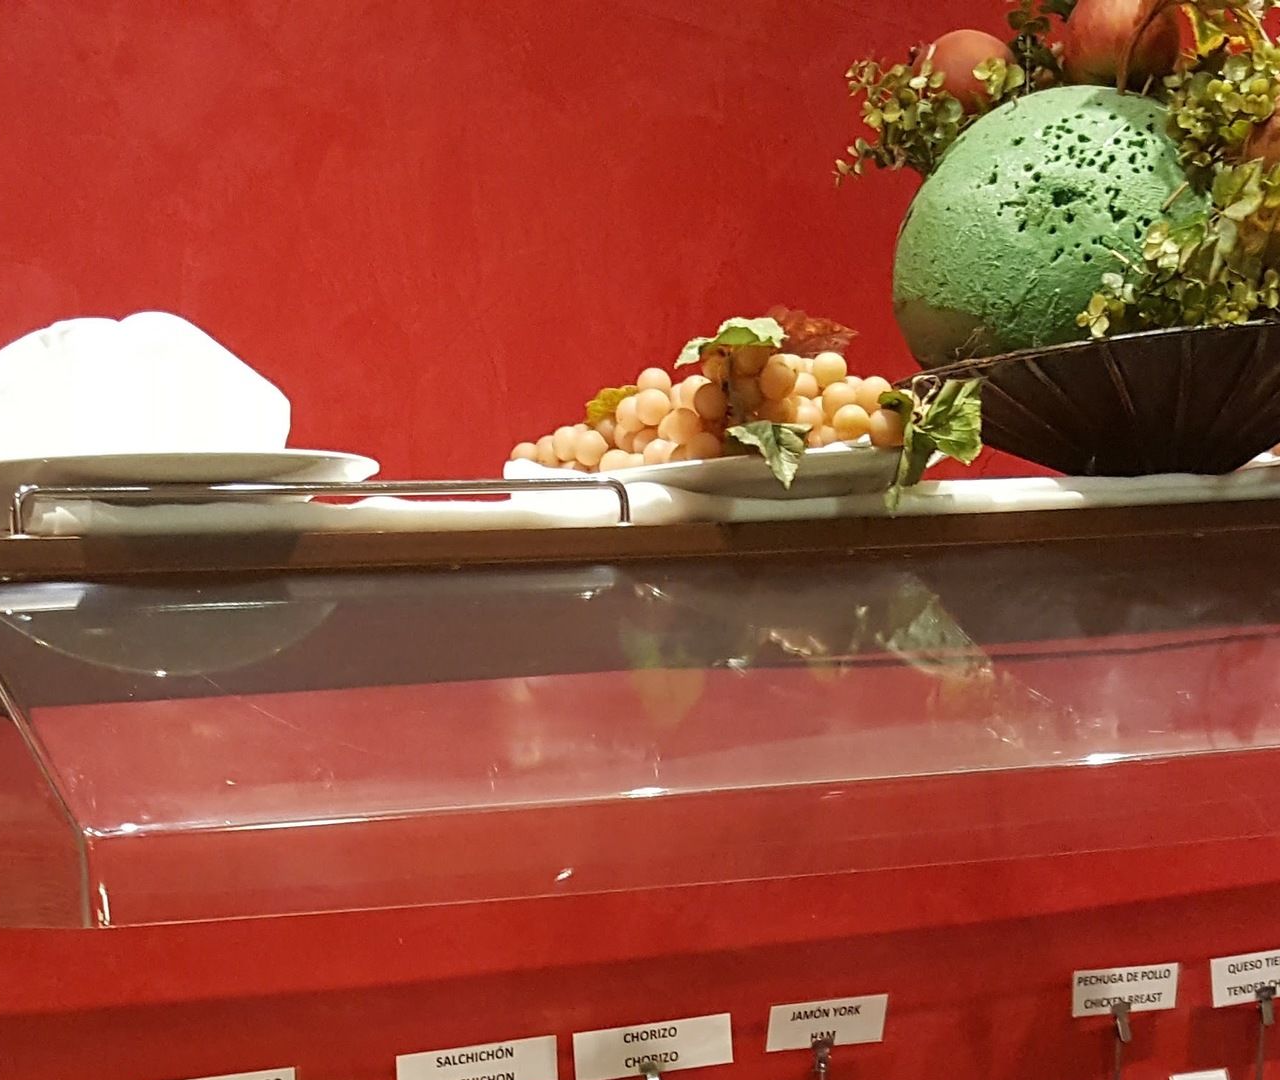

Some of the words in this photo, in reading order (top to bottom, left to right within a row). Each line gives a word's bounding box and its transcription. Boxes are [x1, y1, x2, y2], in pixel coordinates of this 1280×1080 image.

[1228, 959, 1263, 974] QUESO
[1077, 973, 1124, 987] PECHUGA
[1126, 972, 1139, 982] DE
[1141, 968, 1171, 981] POLLO
[1128, 992, 1163, 1005] BREAST
[790, 1006, 830, 1022] JAMÓN
[832, 1005, 862, 1017] YORK
[623, 1026, 678, 1044] CHORIZO
[810, 1030, 837, 1042] HAM
[436, 1045, 514, 1068] SALCHICHÓN
[624, 1051, 679, 1068] CHORIZO
